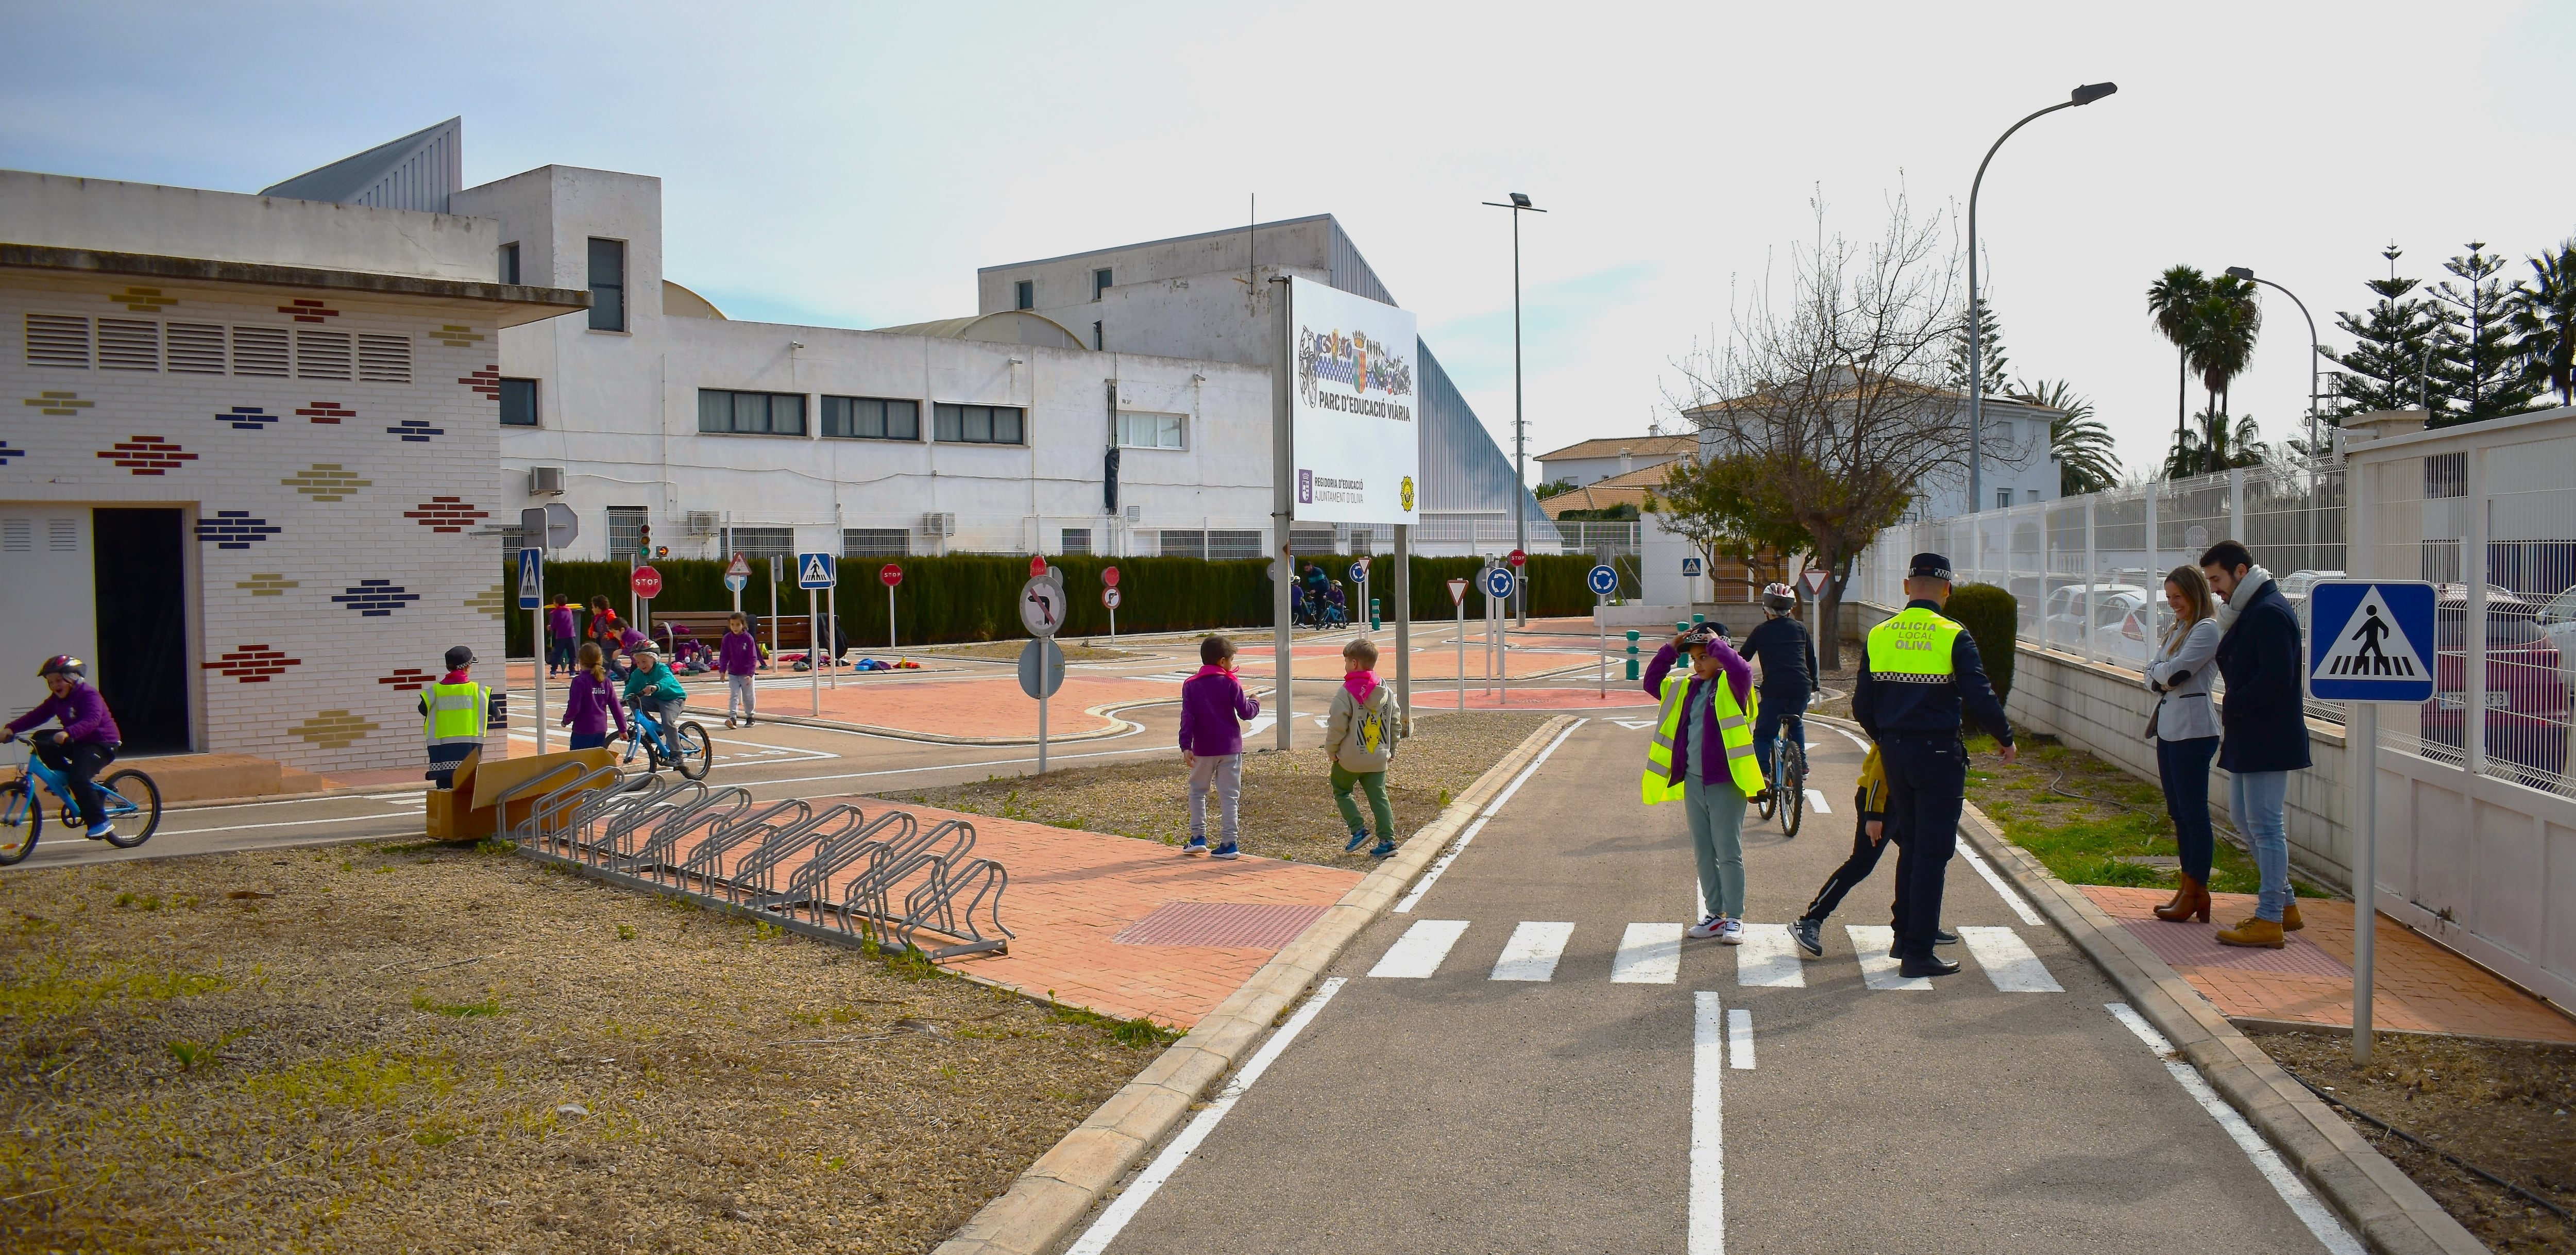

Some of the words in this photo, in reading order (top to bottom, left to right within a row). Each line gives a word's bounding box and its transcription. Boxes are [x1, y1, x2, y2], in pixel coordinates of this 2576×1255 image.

[1319, 391, 1340, 411] PARC
[1342, 394, 1386, 419] D'EDUCACIÓ
[1387, 400, 1411, 422] VIÀRIA
[1315, 477, 1337, 489] REGIDORIA
[1338, 478, 1363, 490] D'EDUCACIÓ
[1315, 490, 1345, 503] AJUNTAMENT
[1346, 492, 1363, 504] D'OLIVA
[1883, 622, 1936, 632] POLICIA
[1899, 631, 1934, 640] LOCAL
[1896, 640, 1932, 651] OLIVA
